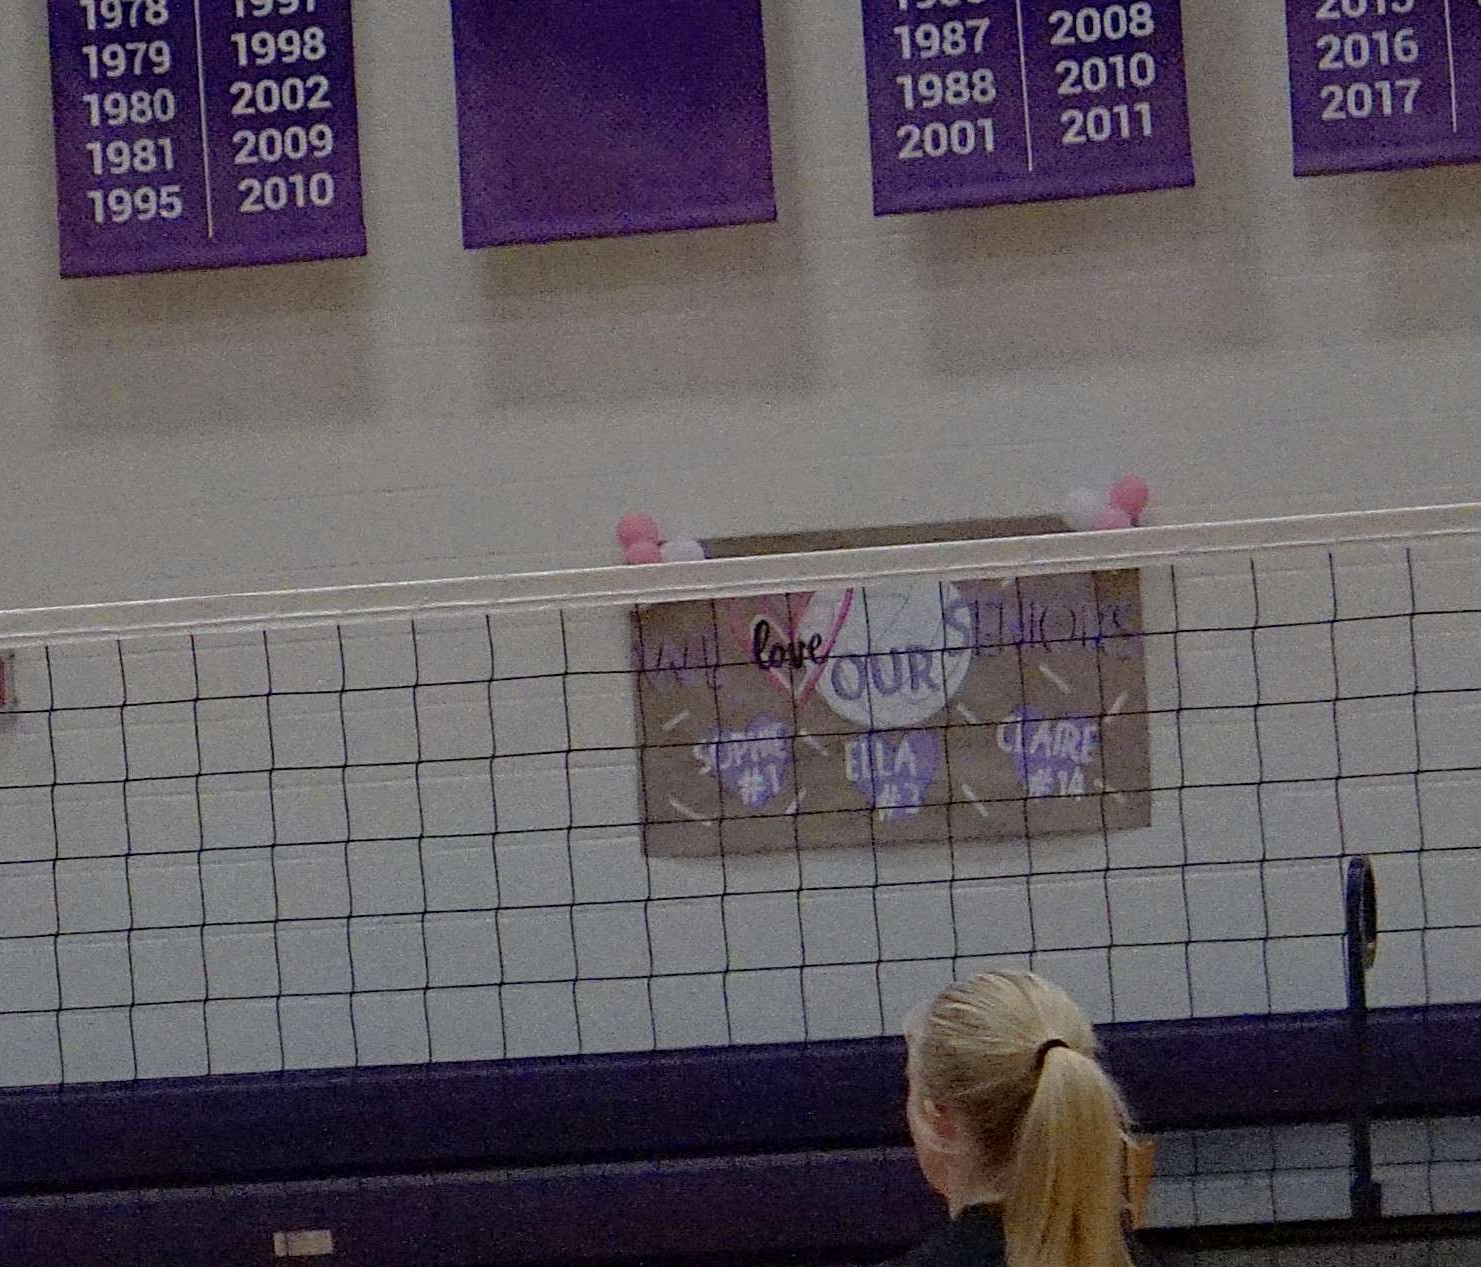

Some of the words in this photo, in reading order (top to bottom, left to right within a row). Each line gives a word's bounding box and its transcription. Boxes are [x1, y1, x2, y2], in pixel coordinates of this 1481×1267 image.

[79, 0, 169, 31] 1978
[1048, 1, 1155, 45] 2008
[230, 26, 327, 67] 1998
[893, 17, 991, 60] 1987
[1316, 27, 1419, 71] 2016
[81, 40, 172, 80] 1979
[1055, 51, 1156, 95] 2010
[82, 88, 176, 127] 1980
[229, 74, 332, 116] 2002
[895, 68, 997, 110] 1988
[1320, 78, 1422, 121] 2017
[232, 123, 334, 165] 2009
[896, 118, 995, 160] 2001
[1060, 101, 1152, 145] 2011
[85, 137, 174, 175] 1981
[87, 184, 183, 224] 1995
[238, 171, 335, 213] 2010
[752, 619, 823, 672] love
[831, 642, 939, 702] OUR
